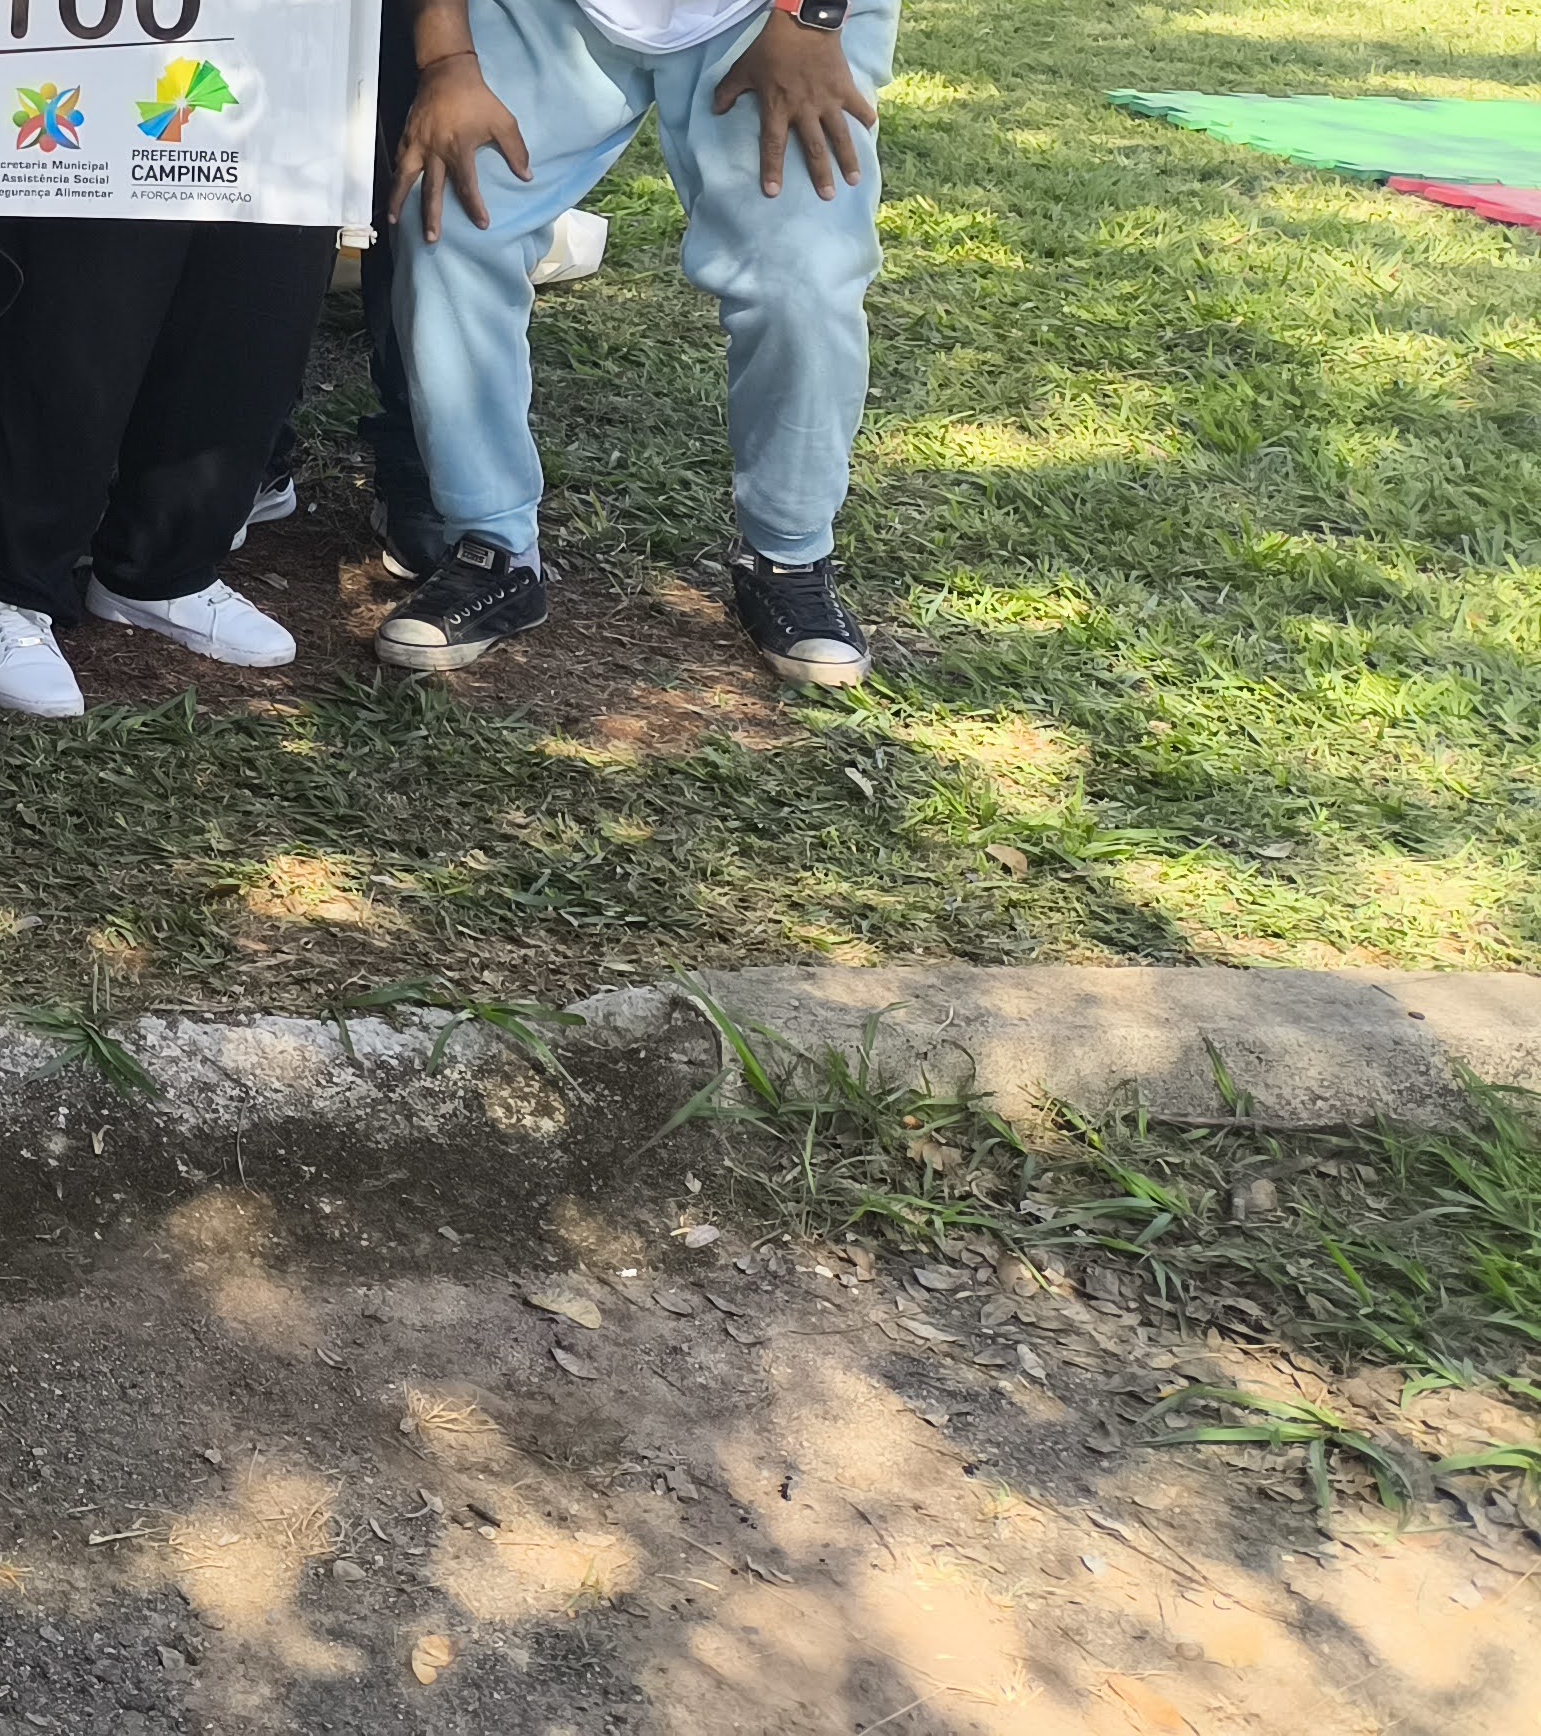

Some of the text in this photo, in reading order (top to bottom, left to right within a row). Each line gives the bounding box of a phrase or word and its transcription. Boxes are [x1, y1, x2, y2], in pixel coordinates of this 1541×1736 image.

[132, 149, 239, 163] PREFEITURA DE
[52, 160, 109, 172] Municipal
[2, 173, 70, 184] Assistência
[74, 174, 109, 185] Social
[131, 164, 238, 183] CAMPINAS
[55, 188, 114, 198] Alimentar
[130, 191, 138, 199] A
[140, 190, 177, 202] FORÇA
[180, 192, 194, 201] DA
